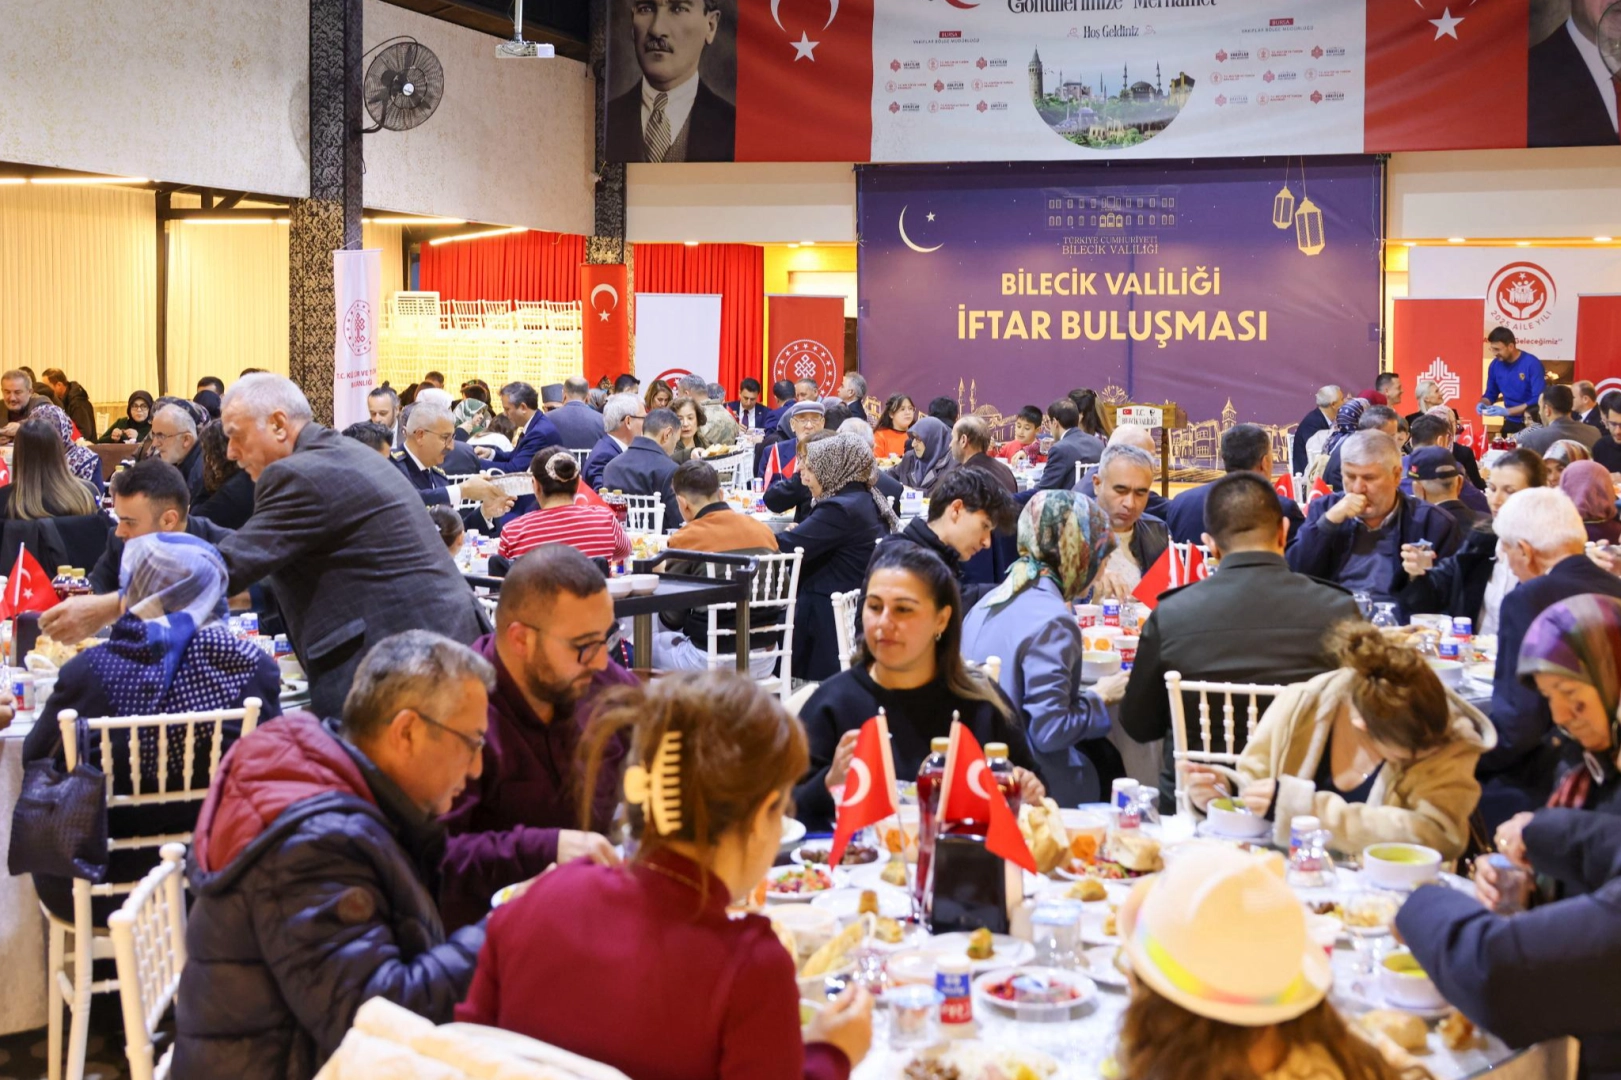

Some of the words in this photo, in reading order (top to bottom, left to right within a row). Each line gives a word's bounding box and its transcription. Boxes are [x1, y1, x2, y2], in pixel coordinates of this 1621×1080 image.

[1083, 25, 1101, 39] Hoş
[1102, 24, 1139, 38] Geldiniz
[1063, 236, 1098, 244] TÜRKİYE
[1100, 235, 1158, 244] CUMHURİYETİ
[1062, 244, 1106, 255] BİLECİK
[1110, 243, 1159, 255] VALİLİĞİ
[1001, 268, 1098, 296] BİLECİK
[1104, 266, 1220, 296] VALİLİĞİ
[958, 304, 1052, 340] İFTAR
[1061, 310, 1267, 348] BULUŞMASI
[1490, 310, 1511, 328] 2025
[1512, 322, 1534, 331] AİLE
[1536, 310, 1552, 326] YILI
